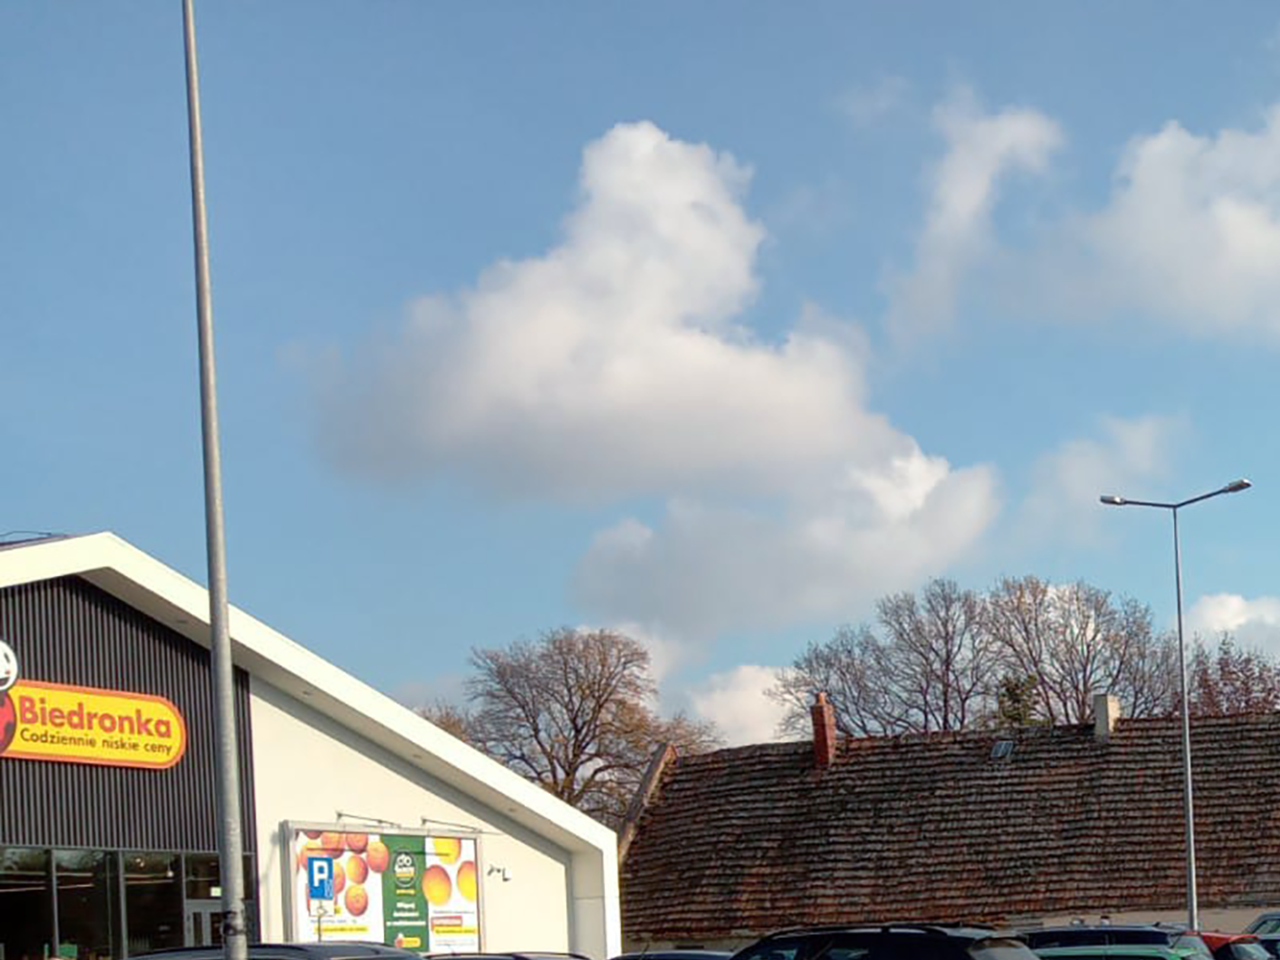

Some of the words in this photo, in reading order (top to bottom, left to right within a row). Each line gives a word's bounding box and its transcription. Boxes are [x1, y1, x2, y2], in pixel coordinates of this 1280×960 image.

[19, 694, 173, 739] Biedronka
[20, 727, 97, 748] Codziennie
[101, 737, 140, 752] niskie
[143, 741, 173, 756] ceny
[313, 860, 328, 887] P
